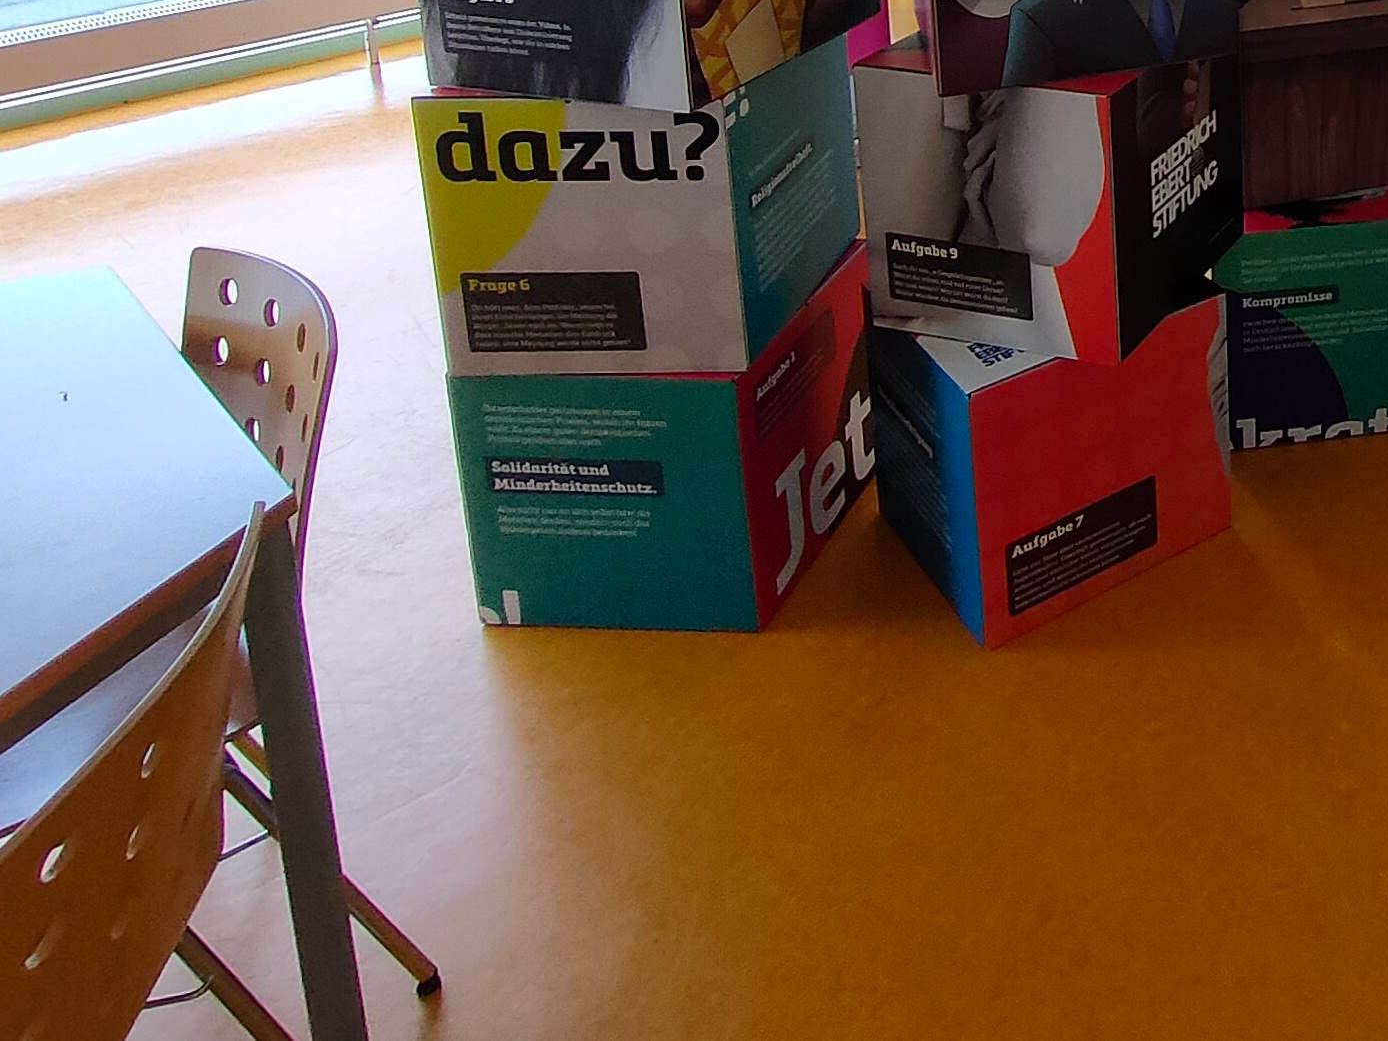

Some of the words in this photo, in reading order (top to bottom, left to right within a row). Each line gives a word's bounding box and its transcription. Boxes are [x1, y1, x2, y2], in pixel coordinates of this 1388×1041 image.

[435, 111, 721, 182] dazu?
[1151, 109, 1217, 187] FRIEDRICH
[1151, 157, 1192, 213] EBERT
[1152, 159, 1219, 239] STIFTUNG
[891, 239, 948, 258] Aufgabe
[949, 248, 959, 259] 9
[467, 278, 516, 294] Frage
[519, 279, 530, 291] 6
[1242, 292, 1333, 309] Kompromisse
[755, 361, 789, 402] Aufgabe
[491, 460, 578, 476] Solidarität
[578, 464, 610, 476] und
[493, 477, 658, 494] Minderheitenschutz.
[1011, 521, 1074, 559] Aufgabe
[1075, 513, 1085, 529] 7
